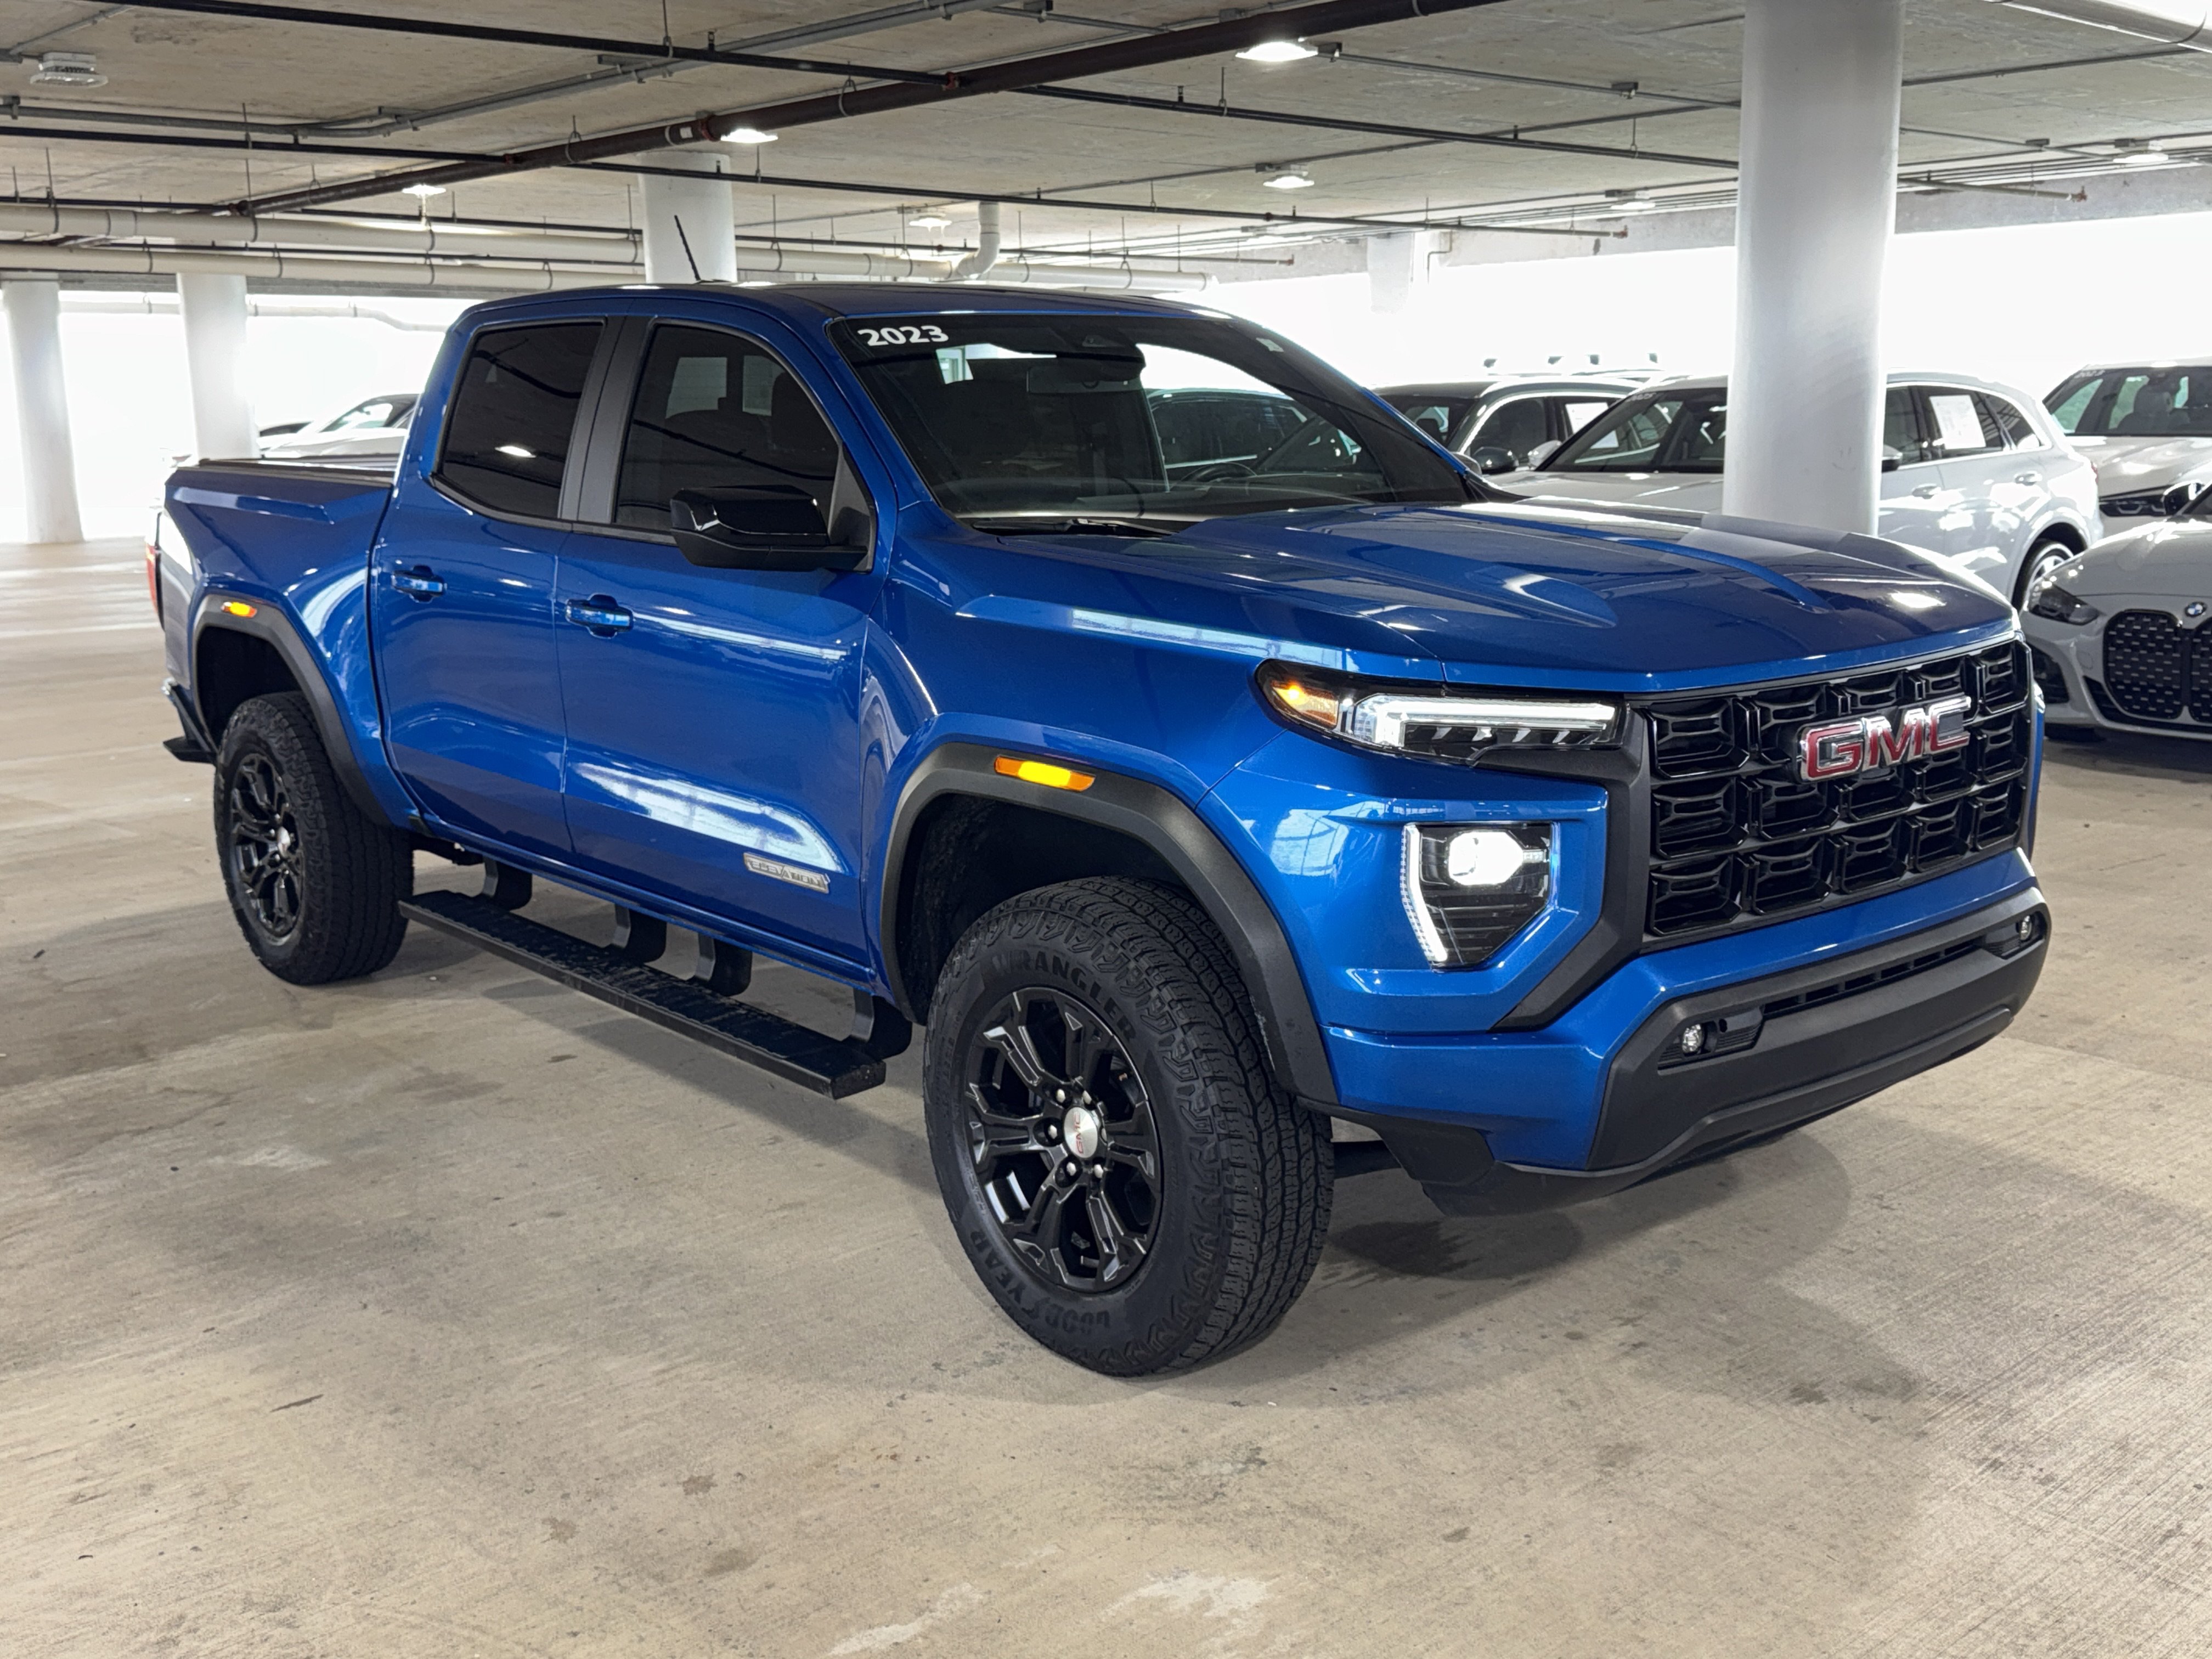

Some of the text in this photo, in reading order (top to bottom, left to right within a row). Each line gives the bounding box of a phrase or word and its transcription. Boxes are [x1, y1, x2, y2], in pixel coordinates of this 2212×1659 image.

[856, 325, 949, 347] 2023
[1800, 696, 1972, 781] GMC
[988, 950, 1136, 1041] WRANGLER
[1073, 1111, 1085, 1155] GMC
